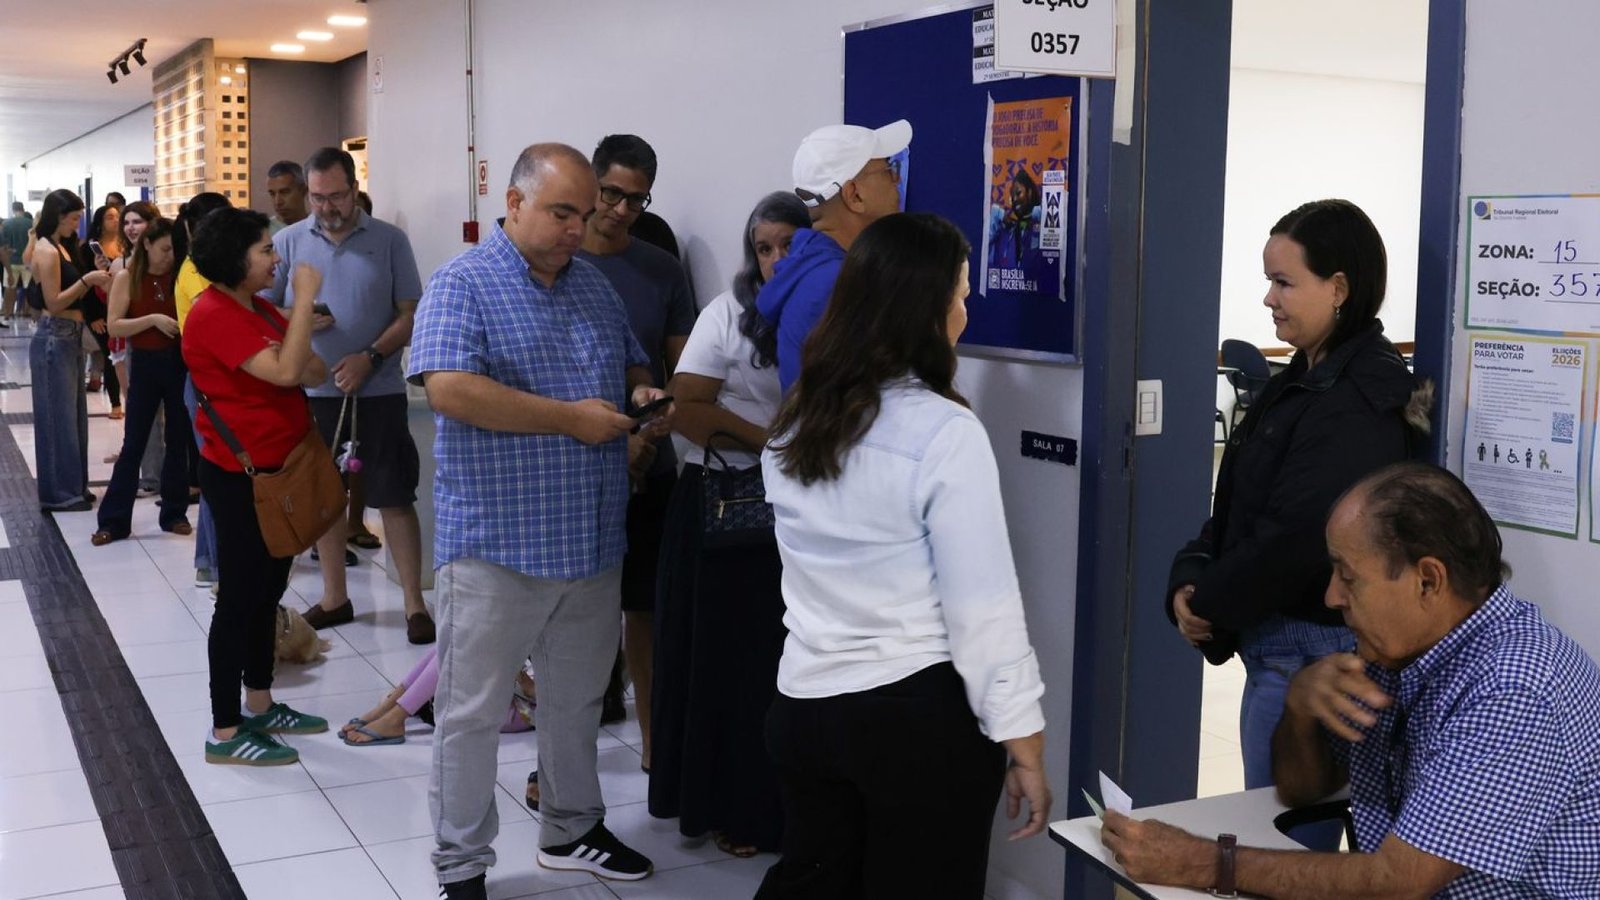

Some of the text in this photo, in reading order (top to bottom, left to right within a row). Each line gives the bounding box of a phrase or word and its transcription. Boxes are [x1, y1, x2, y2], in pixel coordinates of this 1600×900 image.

[1030, 32, 1080, 55] 0357
[1478, 240, 1577, 264] ZONA: 15
[1477, 279, 1540, 300] SEÇÃO:
[1474, 342, 1524, 352] PREFERÊNCIA
[1552, 347, 1582, 356] ELEIÇÕES
[1474, 350, 1524, 360] PARA VOTAR
[1552, 354, 1581, 366] 2026
[1033, 438, 1064, 452] SALA 07
